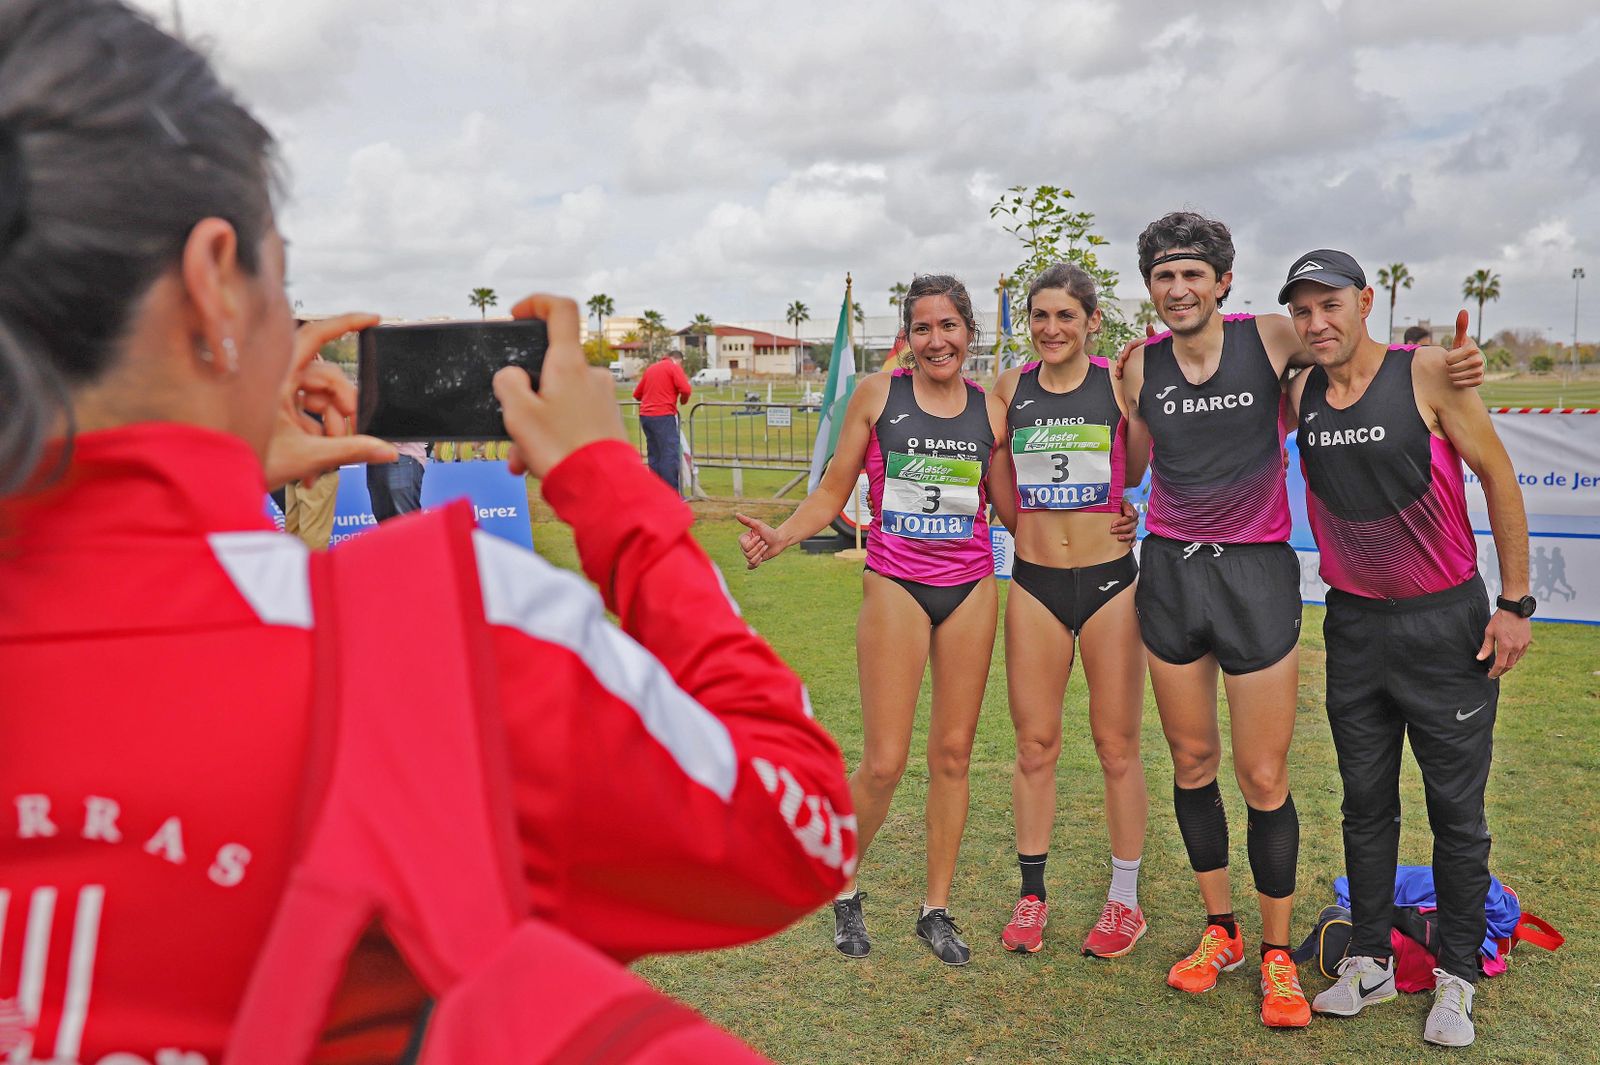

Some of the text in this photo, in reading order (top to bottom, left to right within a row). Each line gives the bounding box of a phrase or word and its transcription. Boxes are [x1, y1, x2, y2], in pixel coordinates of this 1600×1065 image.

[1163, 392, 1254, 415] O BARCO
[1034, 416, 1085, 426] O BARCO
[907, 437, 978, 452] O BARCO
[1308, 426, 1386, 447] O BARCO
[1051, 453, 1070, 483] 3
[1543, 471, 1567, 487] de
[1571, 472, 1600, 491] Jer
[922, 485, 941, 514] 3
[473, 505, 517, 521] Jerez
